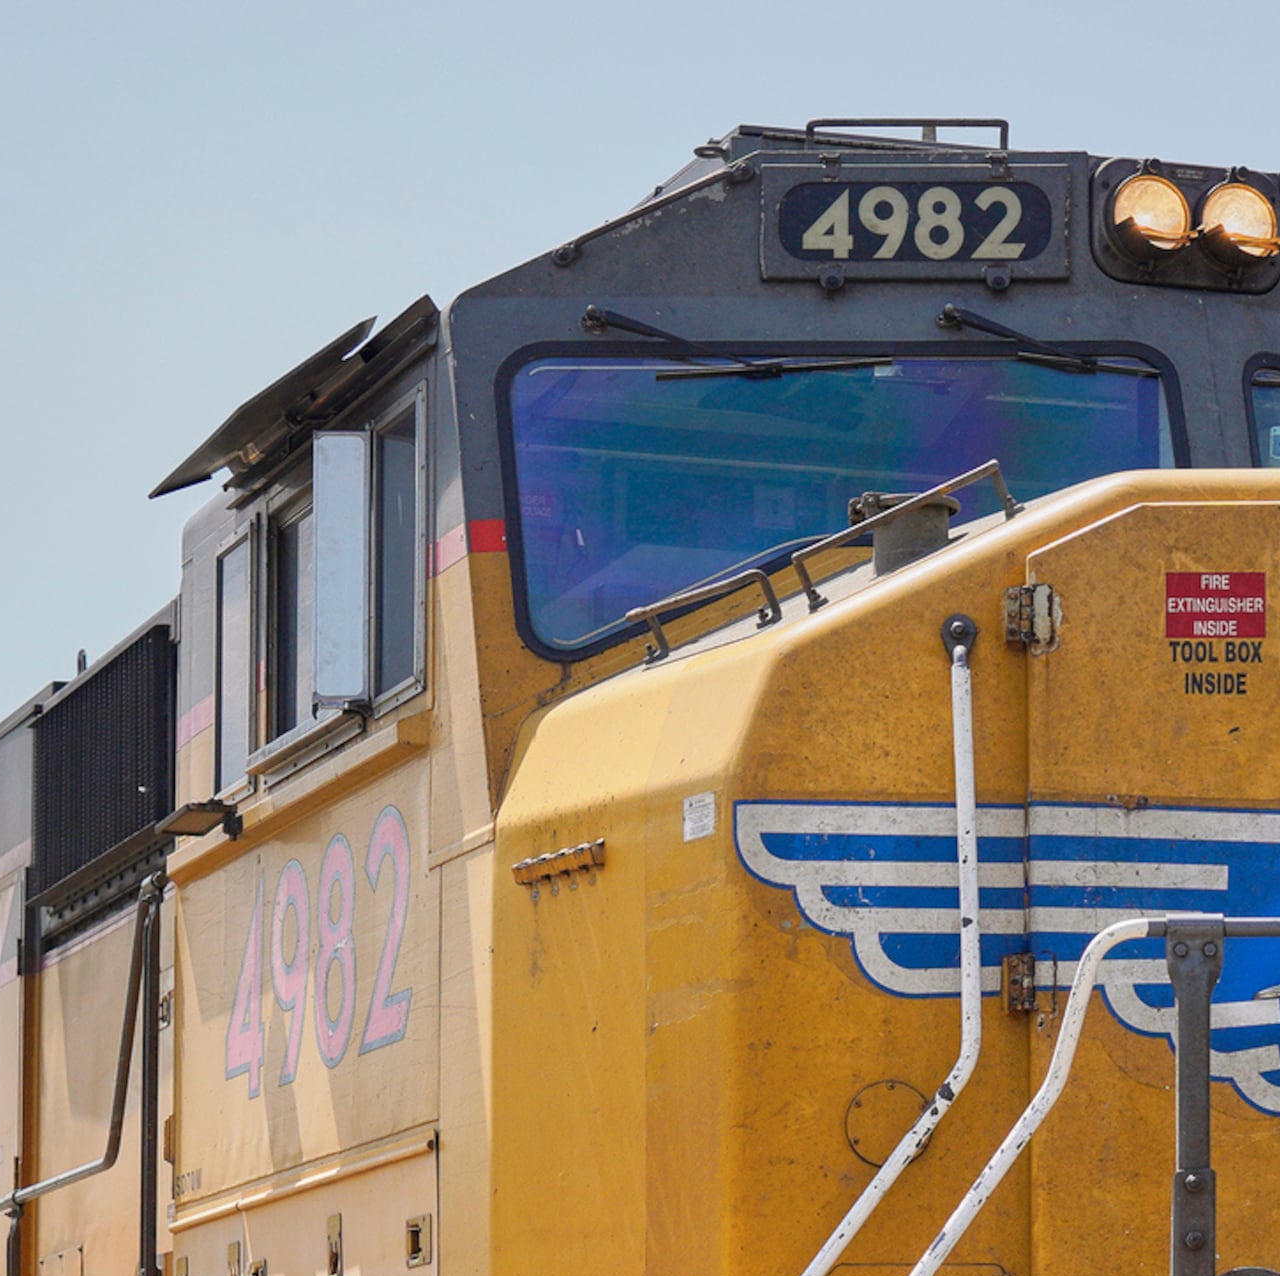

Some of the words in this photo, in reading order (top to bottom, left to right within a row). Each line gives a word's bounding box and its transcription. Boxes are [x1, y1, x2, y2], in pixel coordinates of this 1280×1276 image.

[802, 186, 1026, 260] 4982
[1200, 574, 1230, 591] FIRE
[1167, 597, 1264, 613] EXTINGUISHER
[1193, 620, 1237, 636] INSIDE
[1169, 641, 1218, 662] TOOL
[1225, 641, 1262, 662] BOX
[1185, 672, 1247, 694] INSIDE
[225, 804, 412, 1099] 4982
